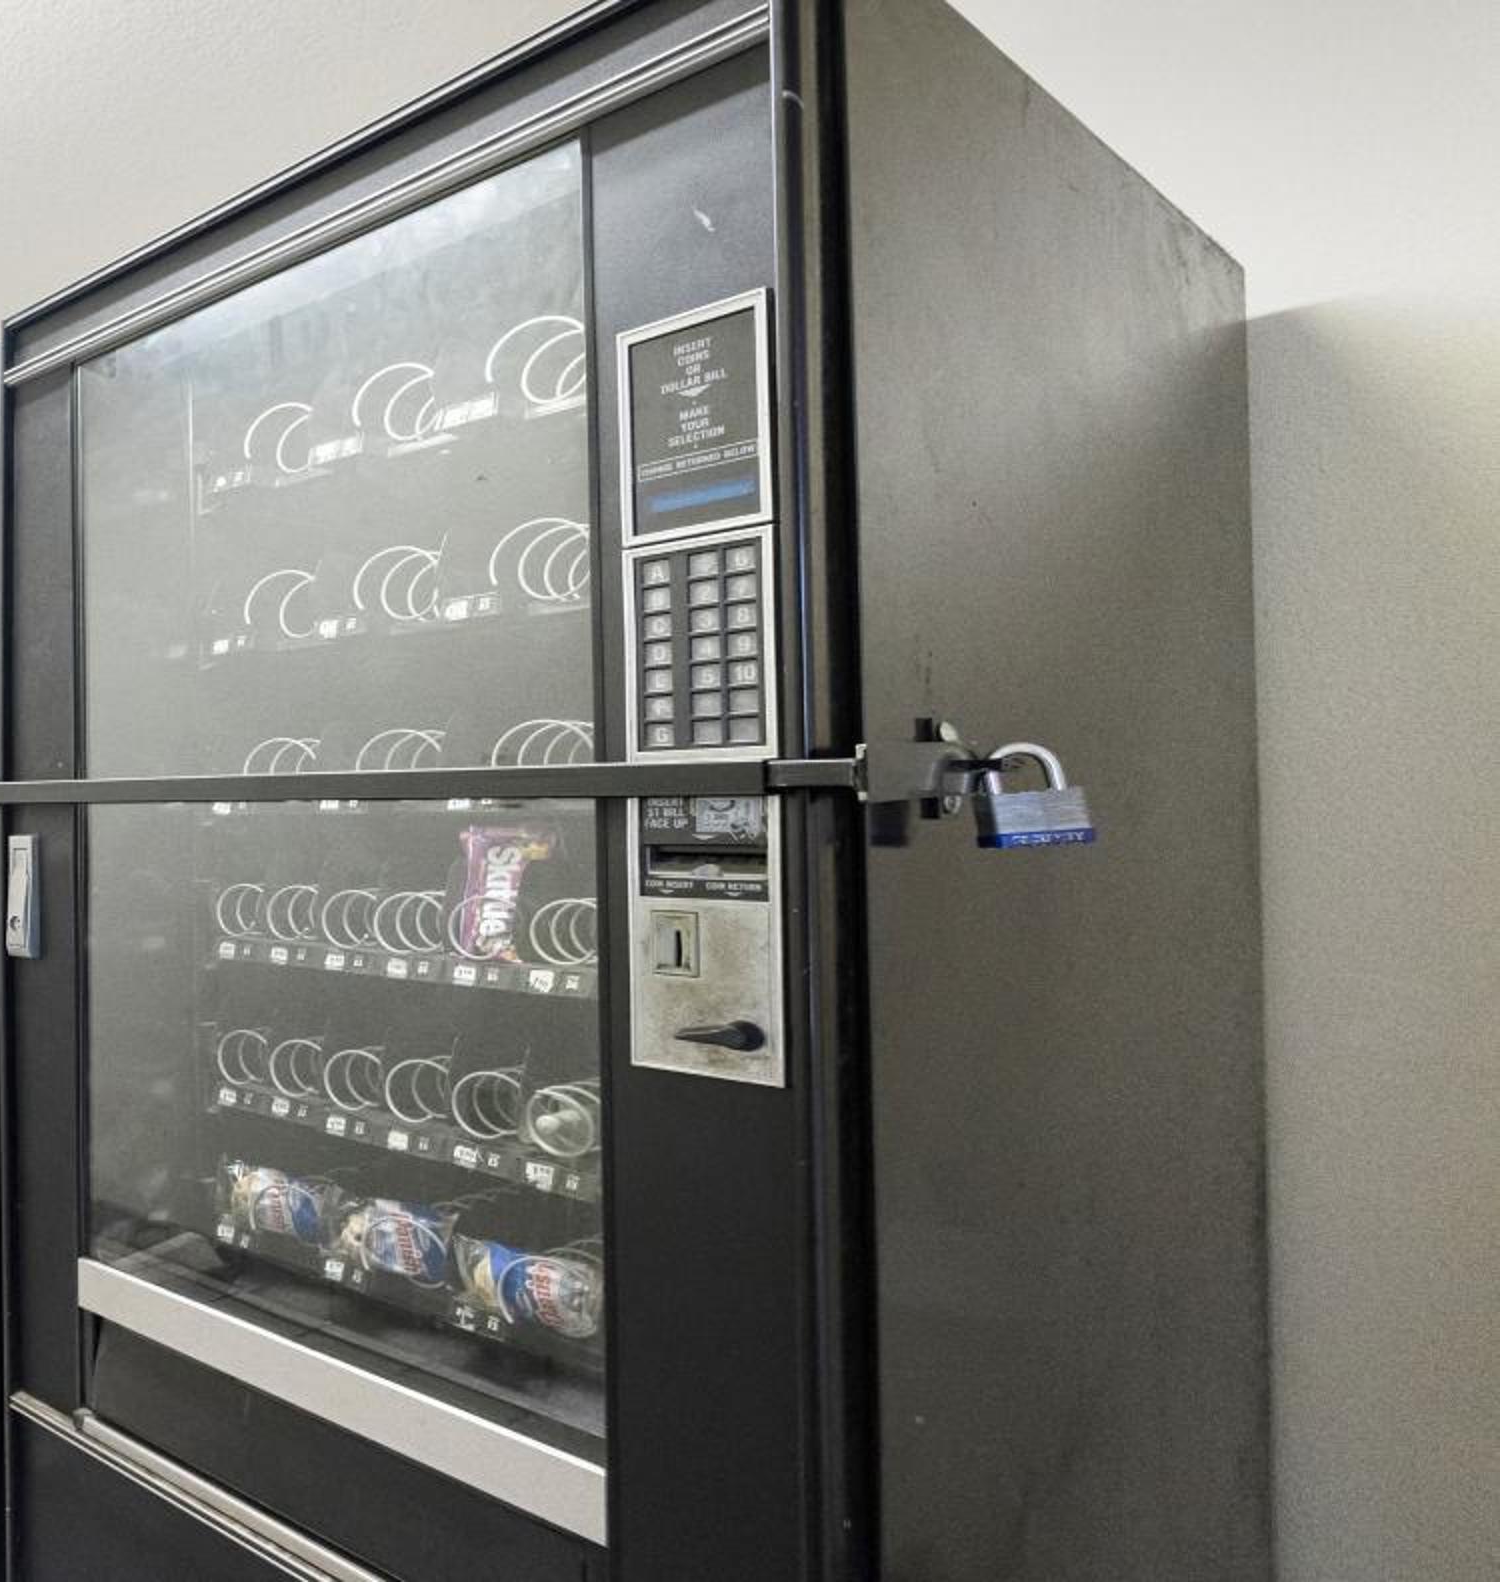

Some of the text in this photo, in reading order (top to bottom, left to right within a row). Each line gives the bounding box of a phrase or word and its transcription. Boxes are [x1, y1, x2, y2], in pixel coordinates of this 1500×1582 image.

[673, 337, 712, 356] INSERT
[677, 350, 709, 367] COINS
[685, 364, 701, 375] OR
[660, 368, 727, 395] DOLLAR BILL
[679, 406, 709, 421] MAKE
[681, 417, 709, 433] YOUR
[668, 425, 725, 448] SELECTION
[676, 452, 721, 469] RETURNED
[723, 444, 756, 458] BELOW
[663, 807, 684, 817] BILL
[645, 817, 689, 829] FACE UP
[645, 879, 762, 891] COIN INSERT COIN RETURN
